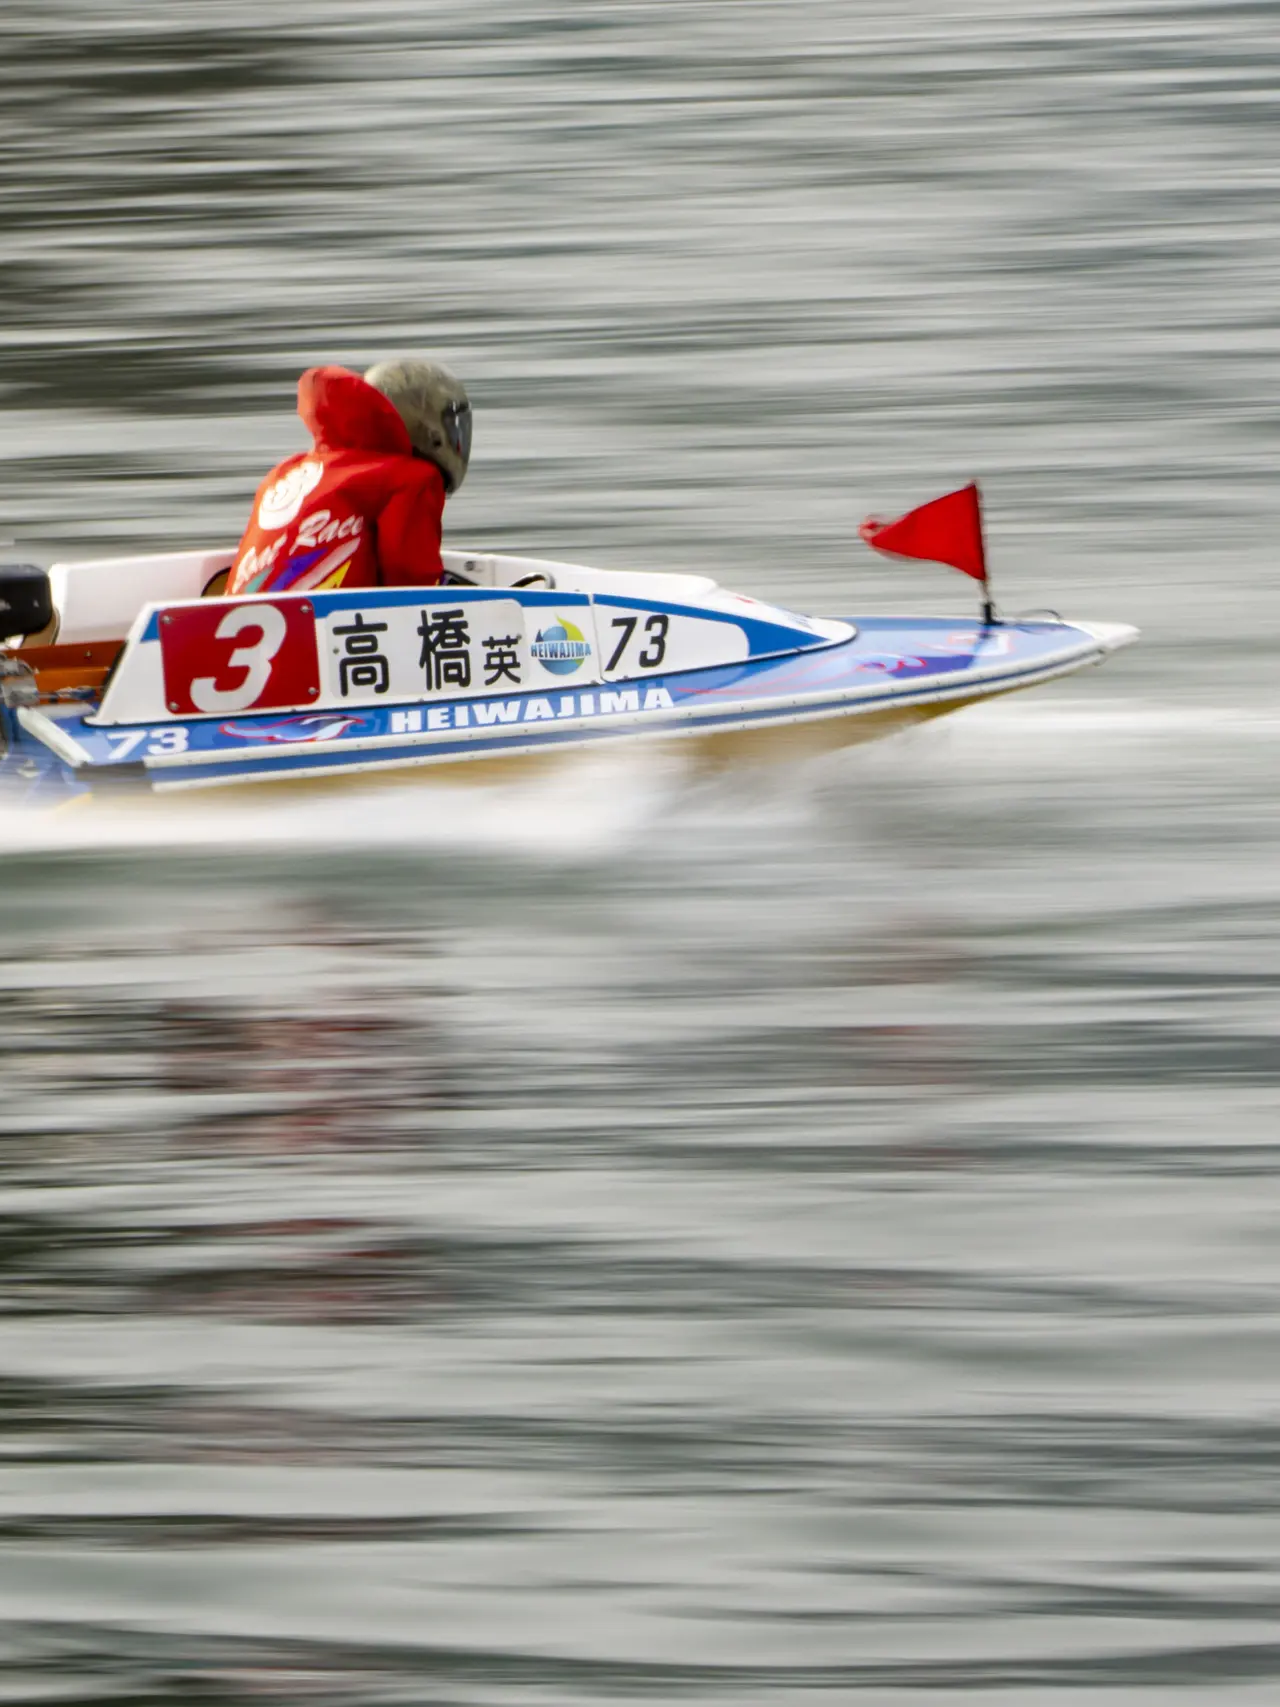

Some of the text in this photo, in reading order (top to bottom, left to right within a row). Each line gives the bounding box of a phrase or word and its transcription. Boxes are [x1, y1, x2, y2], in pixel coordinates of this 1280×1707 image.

[189, 603, 287, 713] 3
[332, 609, 522, 697] 高橋英
[530, 642, 592, 659] HEIWAJIMA
[605, 614, 669, 672] 73
[391, 687, 674, 733] HEIWAJIMA
[106, 727, 189, 760] 73
